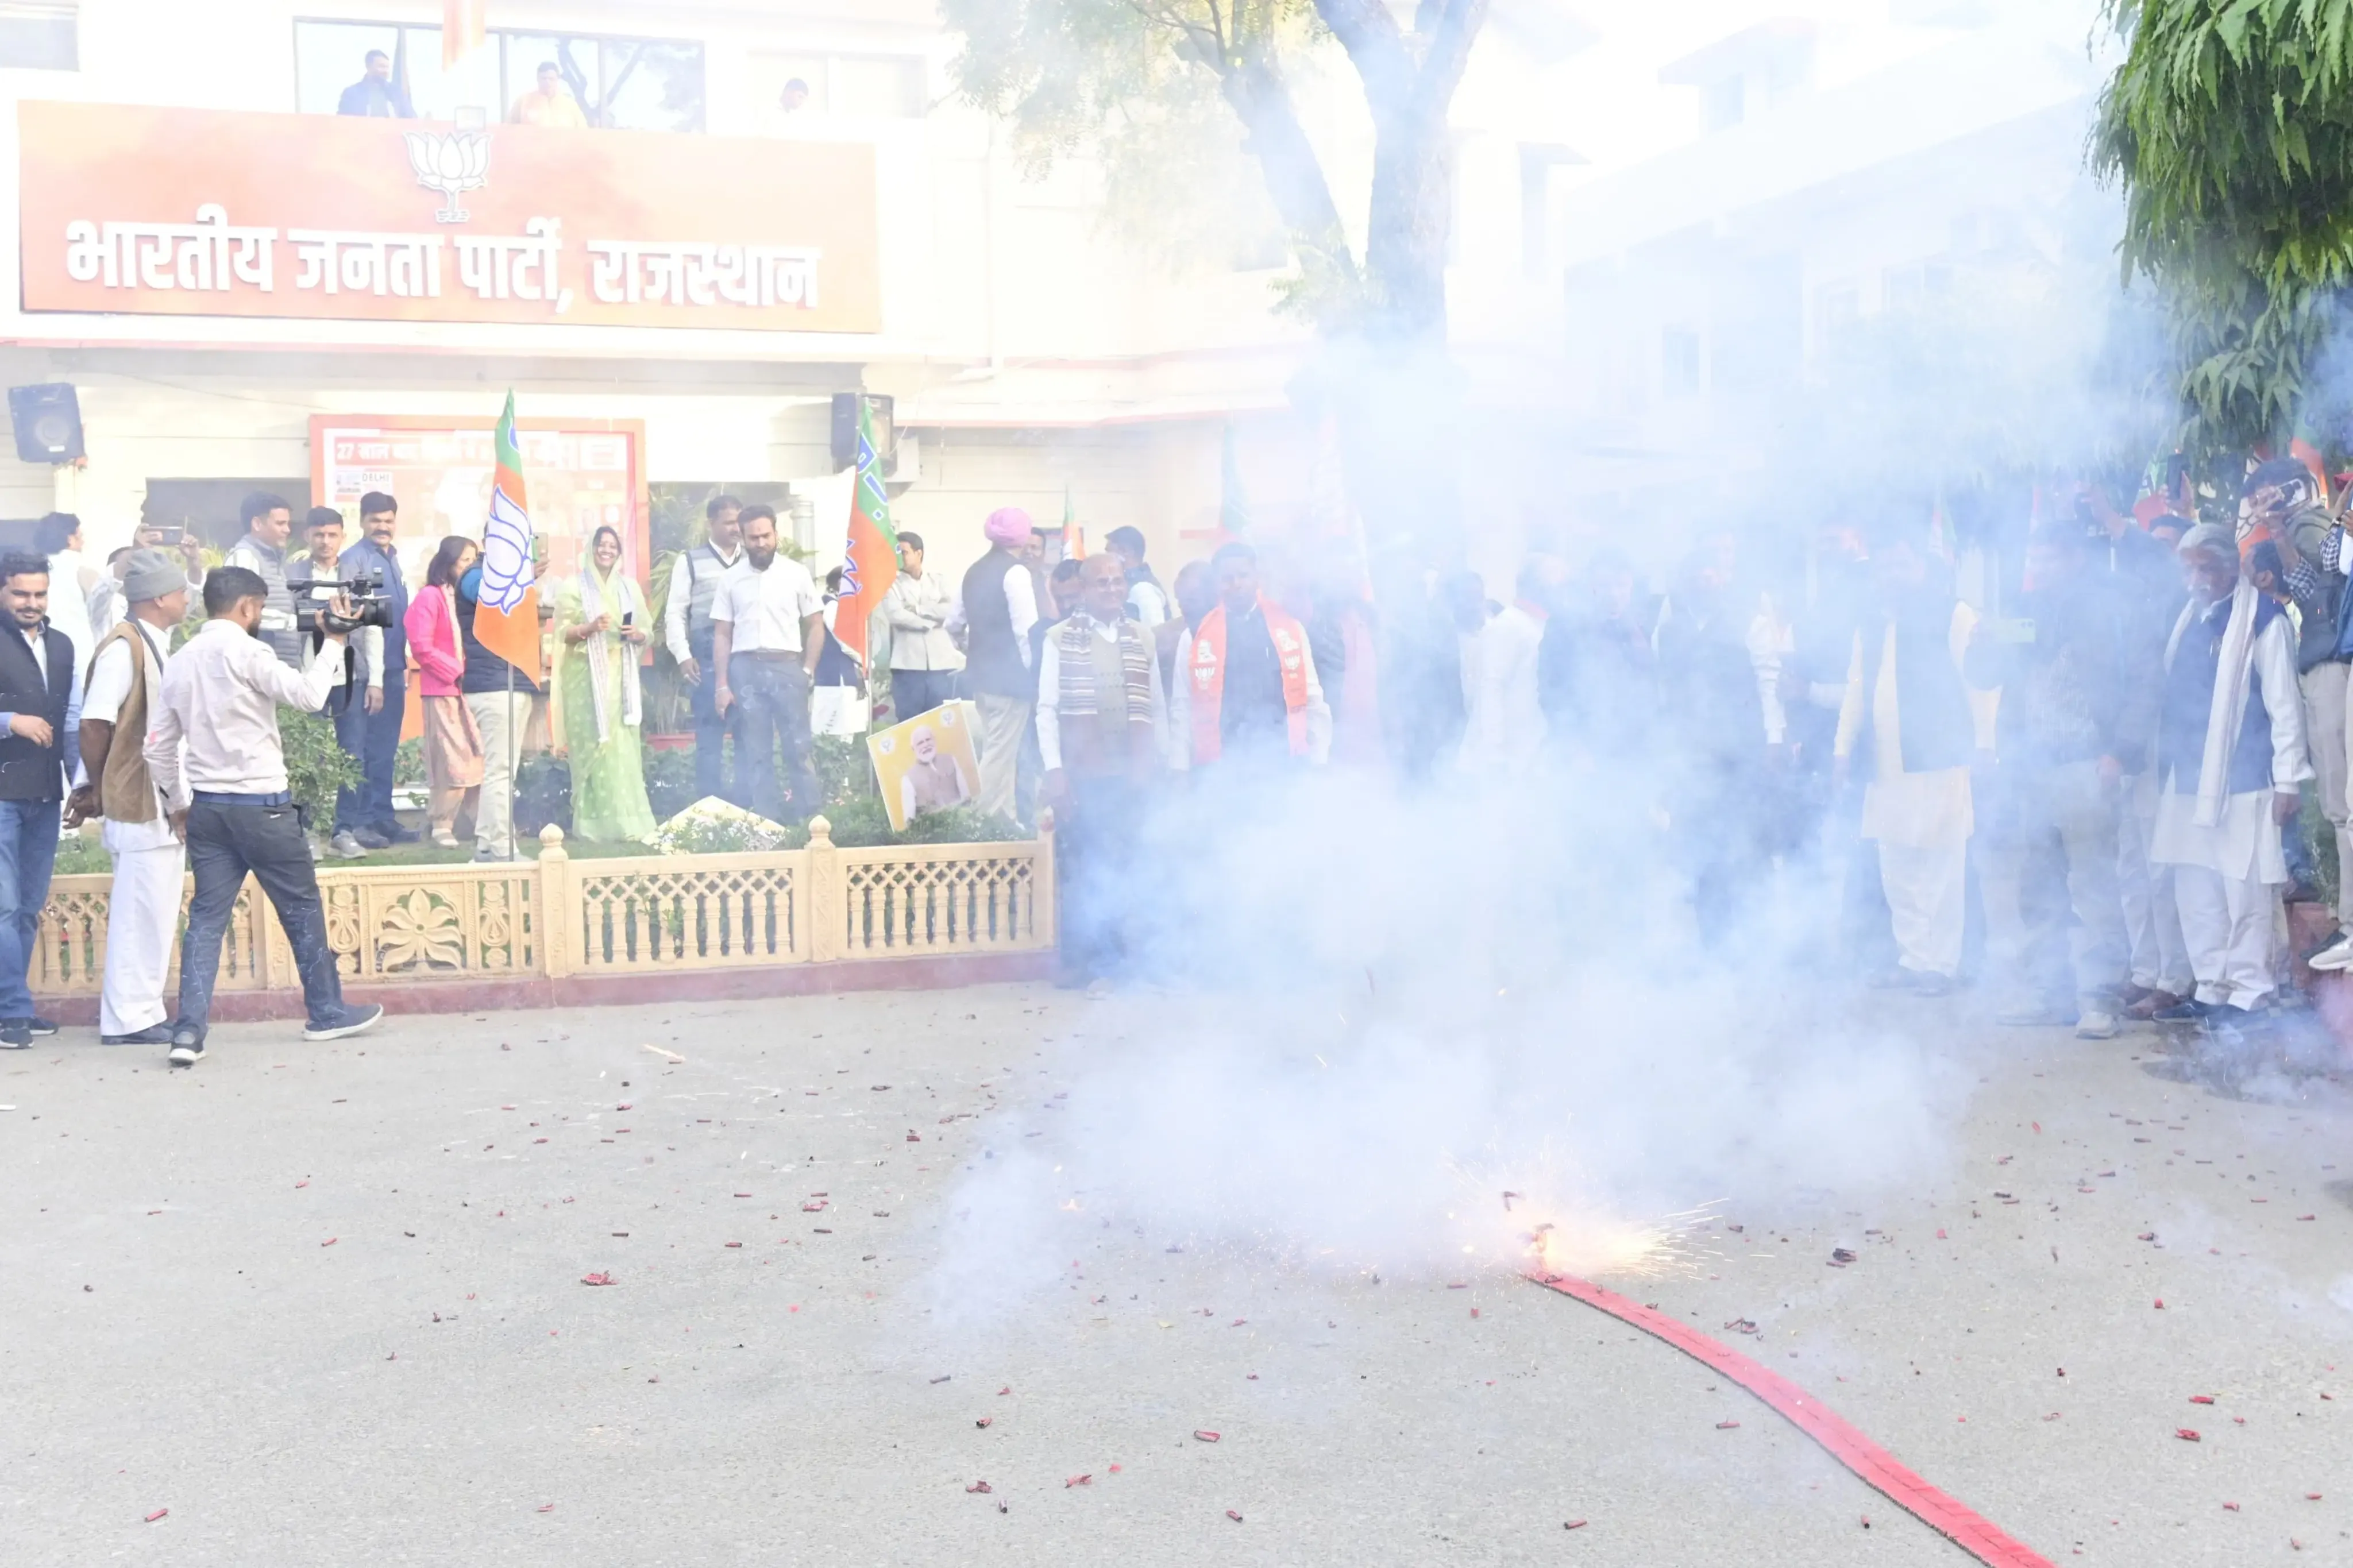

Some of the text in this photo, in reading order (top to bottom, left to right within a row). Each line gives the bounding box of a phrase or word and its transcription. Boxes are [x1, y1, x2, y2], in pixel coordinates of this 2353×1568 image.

[66, 203, 822, 314] भारतीय जनता पार्टी, राजस्थान
[337, 443, 354, 459] 27
[361, 473, 390, 482] DELHI
